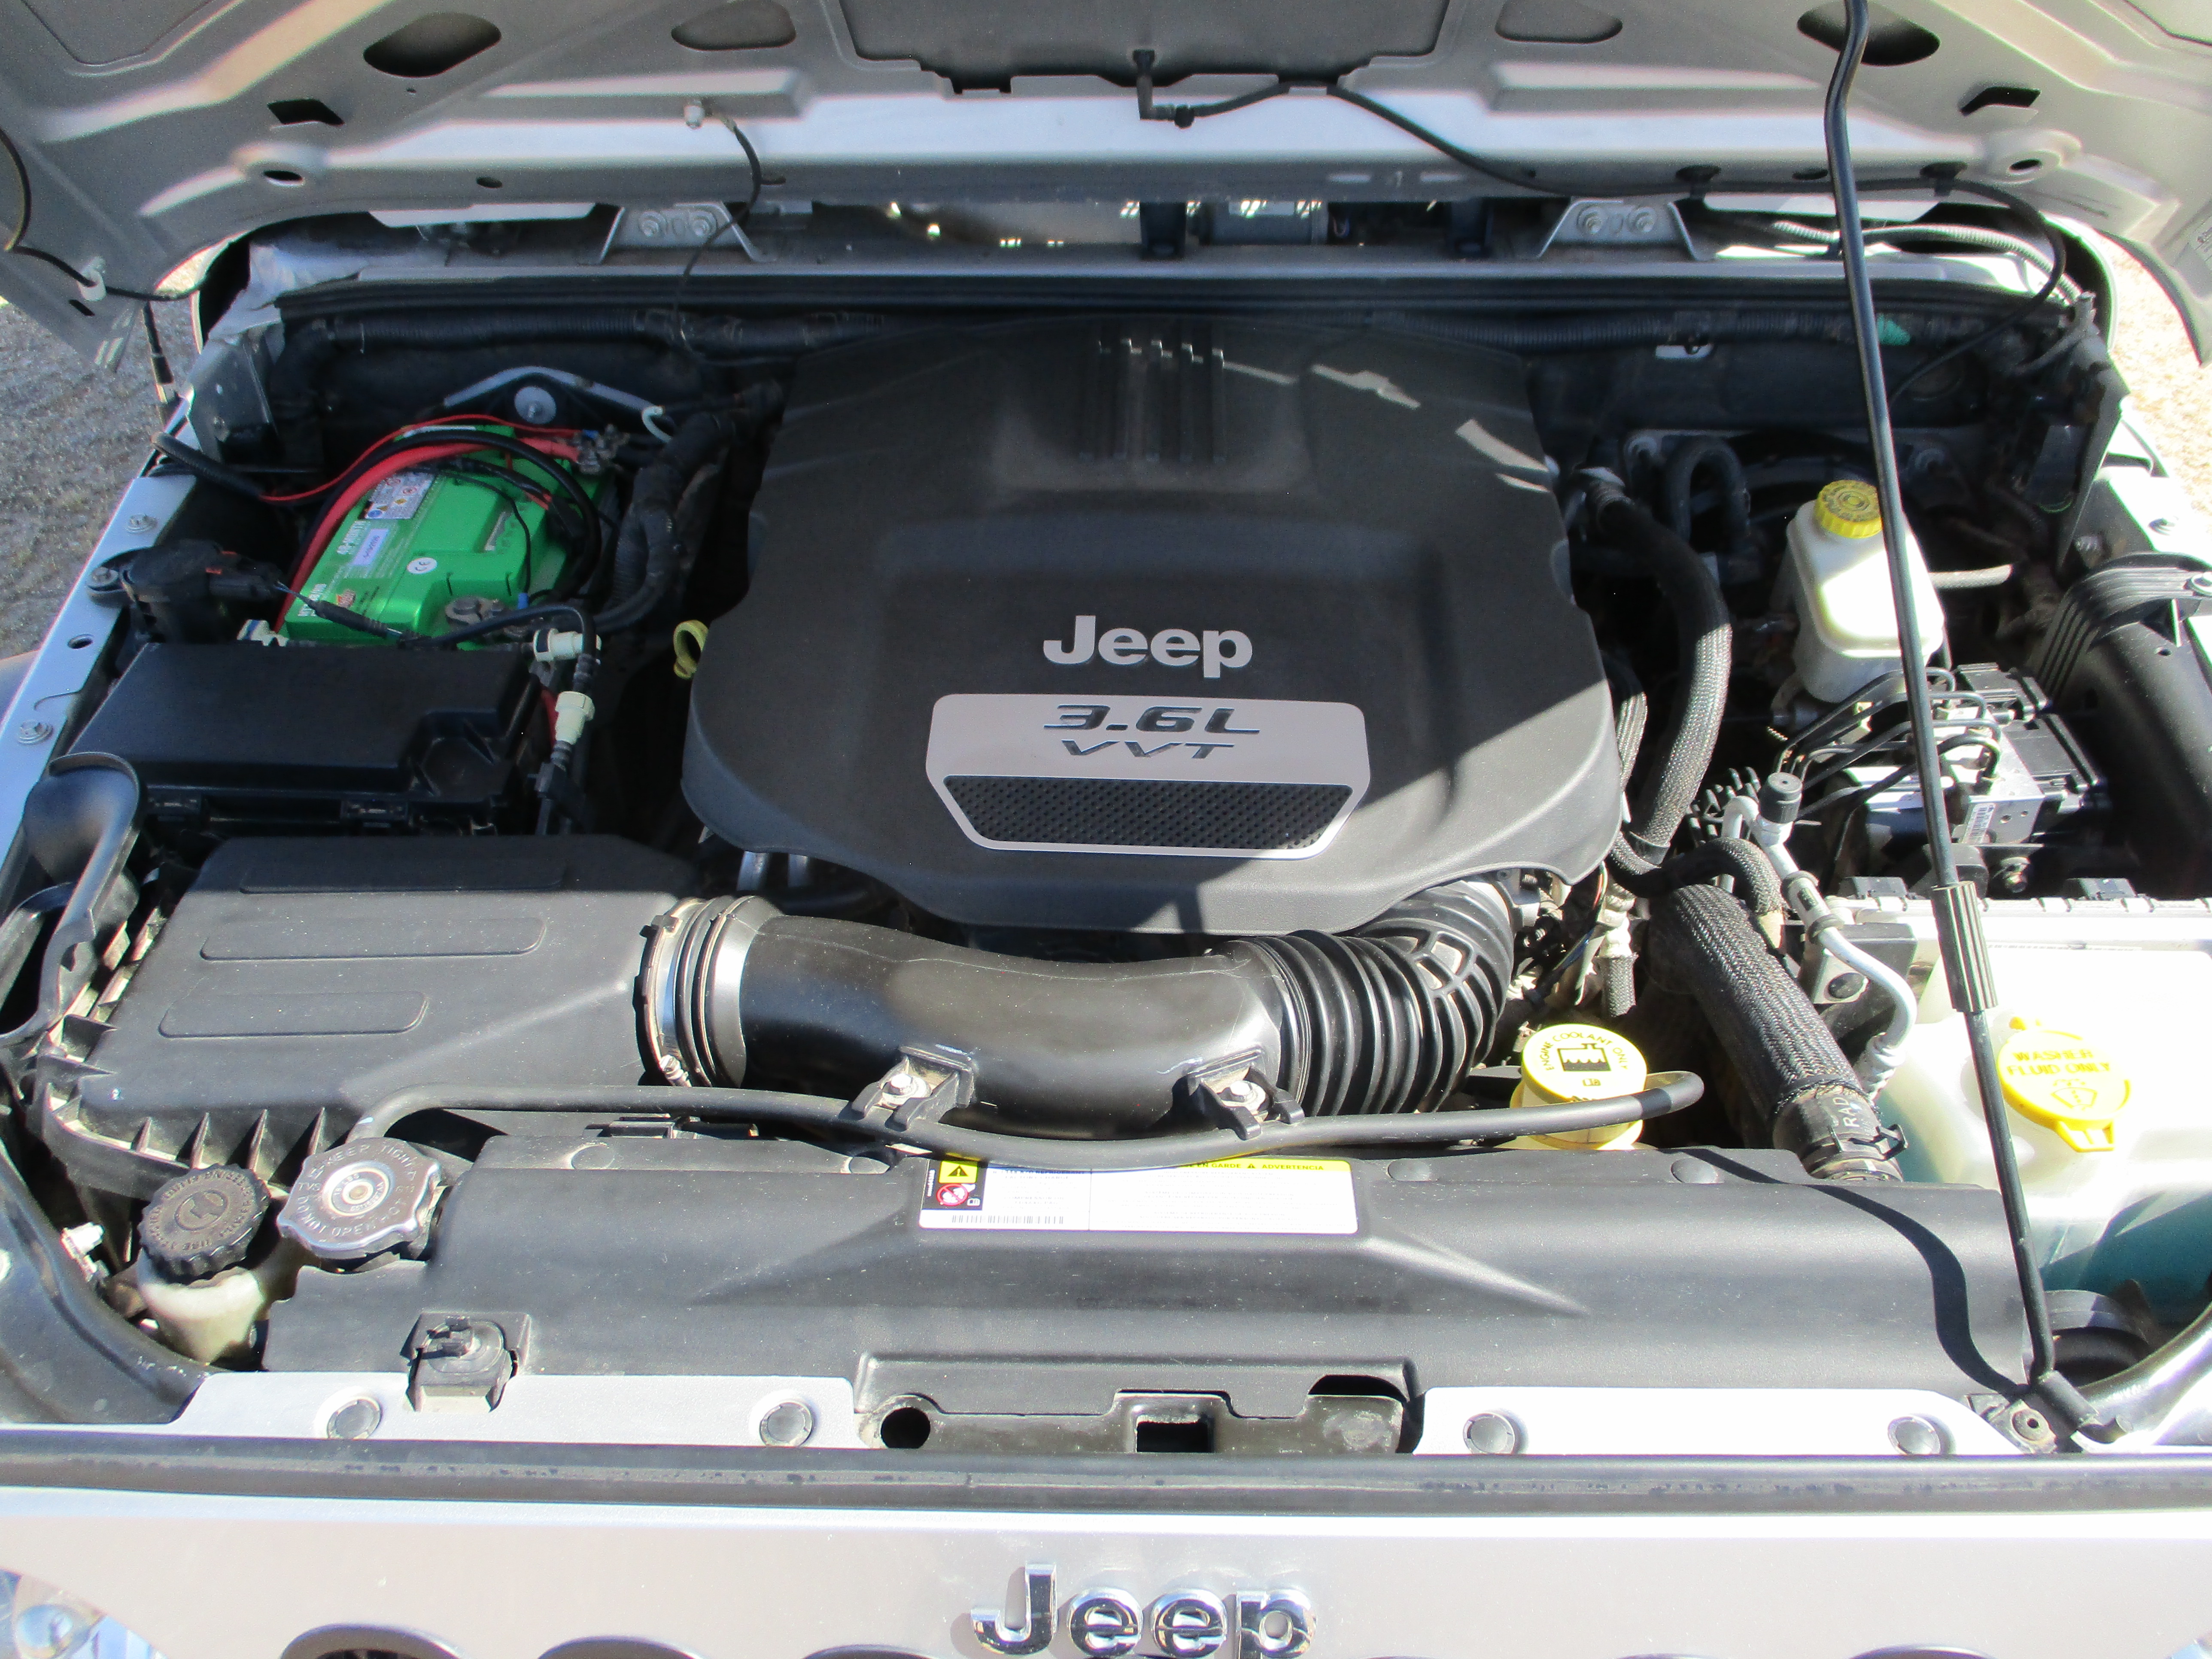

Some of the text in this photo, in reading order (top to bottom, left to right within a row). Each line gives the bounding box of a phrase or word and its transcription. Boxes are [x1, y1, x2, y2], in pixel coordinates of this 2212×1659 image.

[1043, 615, 1253, 678] Jeep
[1045, 703, 1260, 735] 3.6L
[1062, 739, 1235, 760] VVT
[1540, 1032, 1628, 1070] ENGINE COOLANT ONLY
[2013, 1049, 2094, 1061] WASHER
[2007, 1062, 2112, 1076] FLUID ONLY
[1833, 1097, 1860, 1127] RAD
[326, 1144, 371, 1164] KEEP
[299, 1182, 322, 1191] TVS
[970, 1562, 1317, 1659] Jeep
